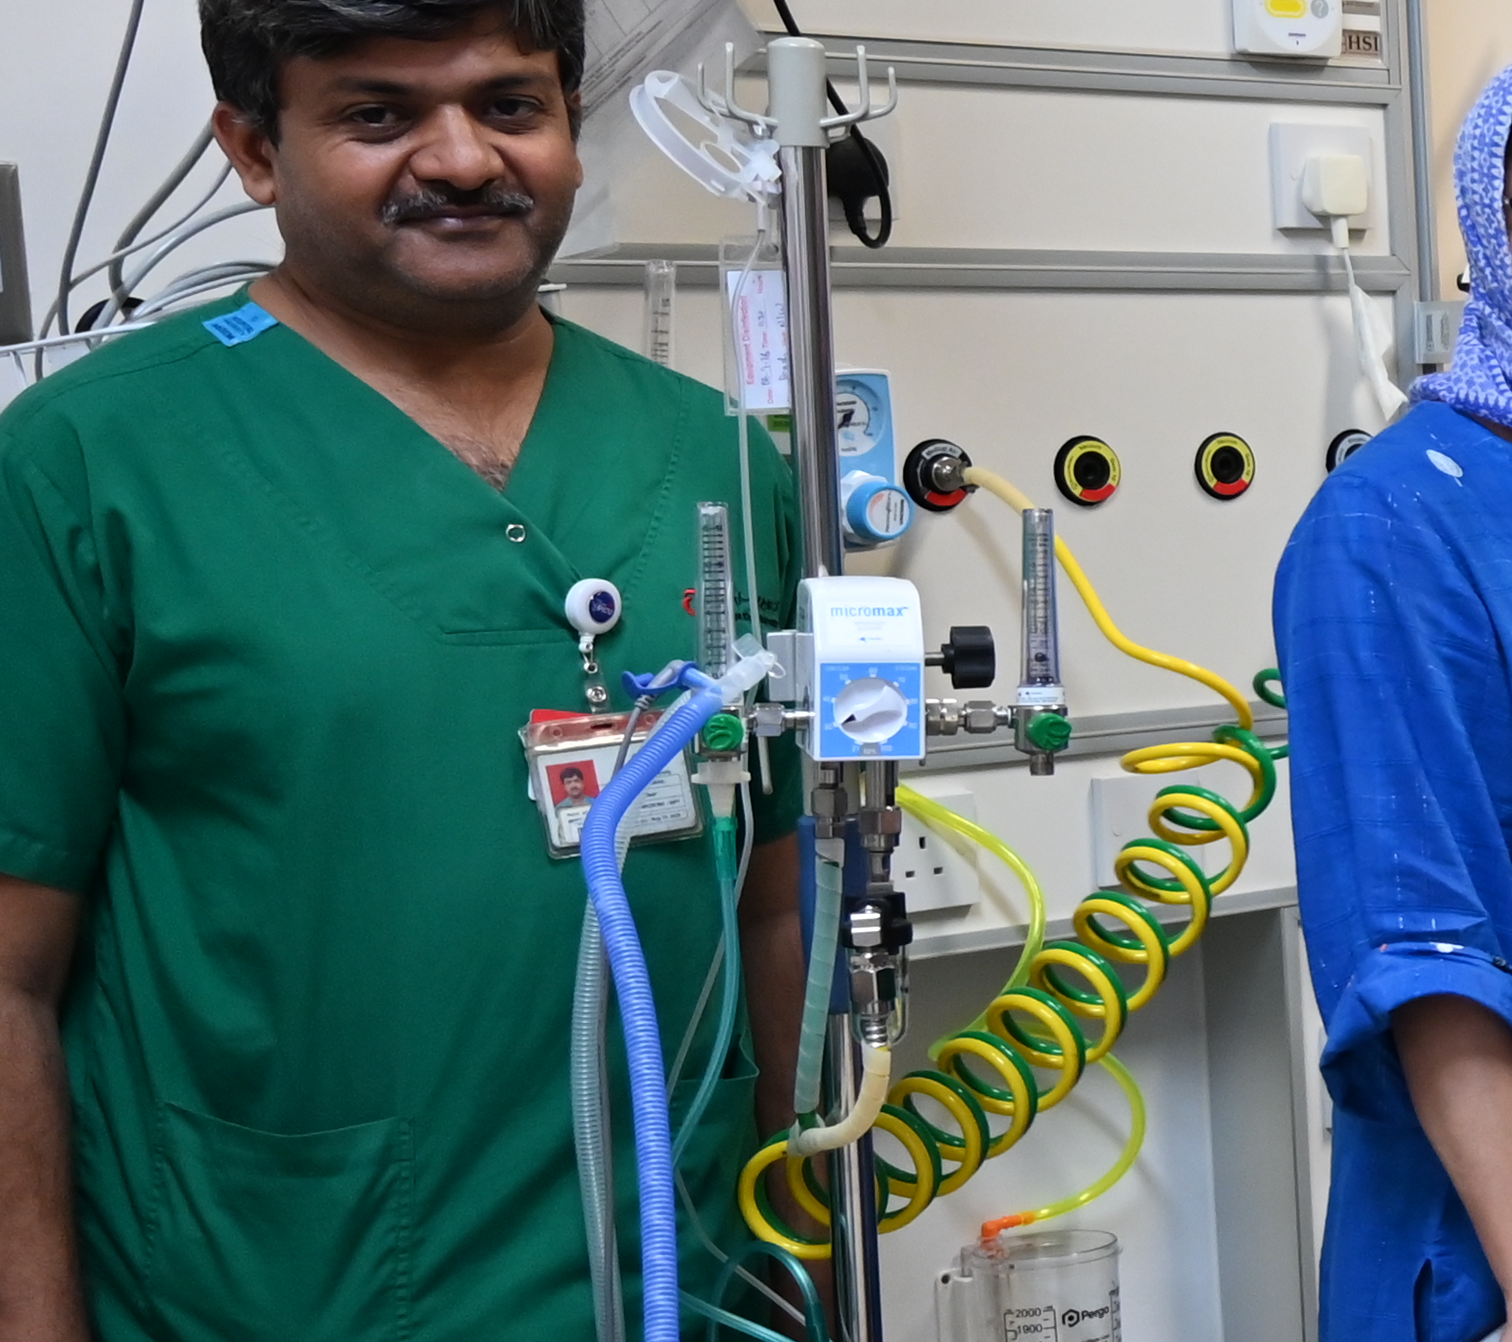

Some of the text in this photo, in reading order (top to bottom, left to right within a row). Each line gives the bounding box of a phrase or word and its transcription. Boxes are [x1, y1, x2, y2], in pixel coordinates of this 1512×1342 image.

[1348, 34, 1379, 52] HSI
[830, 606, 907, 617] micromax
[1015, 1307, 1042, 1318] 2000
[1017, 1324, 1043, 1334] 1900
